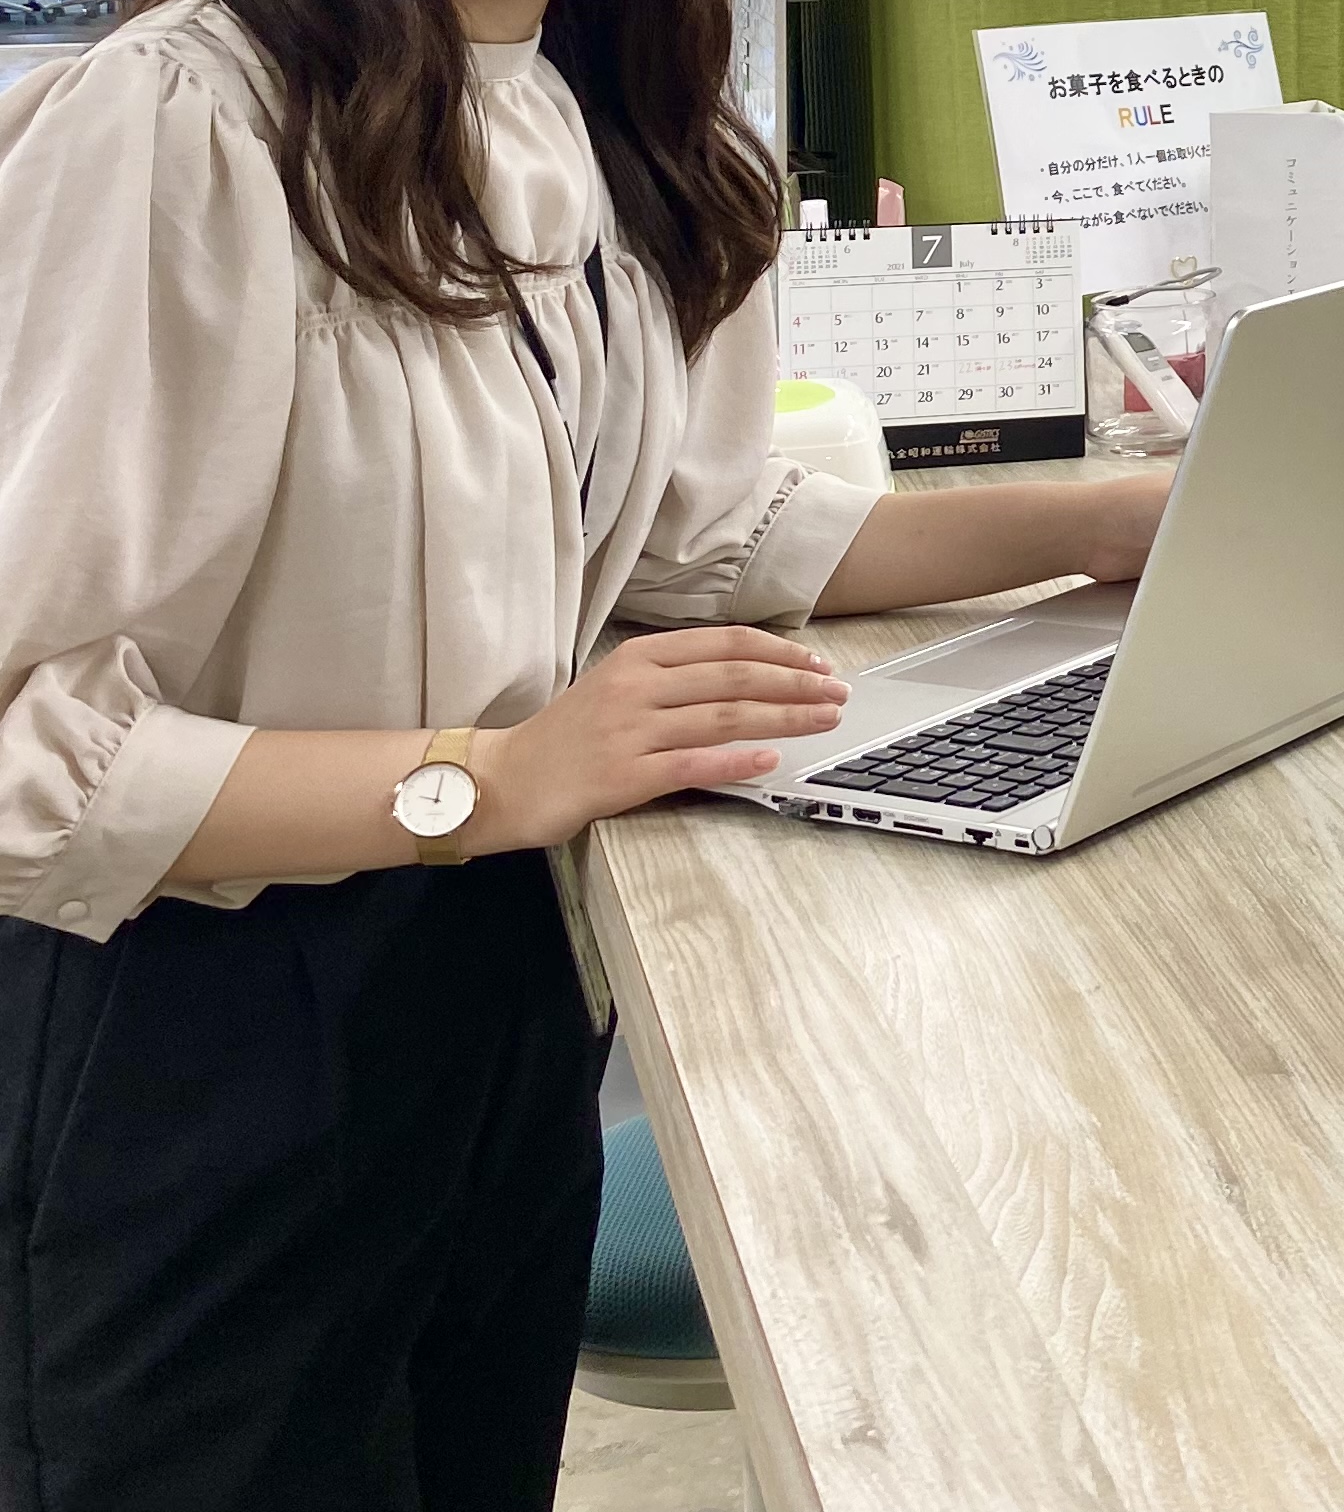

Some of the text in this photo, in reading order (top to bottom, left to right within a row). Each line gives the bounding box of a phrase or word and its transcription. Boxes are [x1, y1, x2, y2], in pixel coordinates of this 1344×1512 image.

[1048, 65, 1224, 99] お菓子を食べるときの
[1118, 104, 1175, 128] RULE
[844, 245, 851, 254] 6
[922, 235, 943, 264] 7
[959, 260, 975, 268] July
[996, 280, 1004, 291] 2
[1035, 278, 1043, 289] 3
[793, 304, 1049, 328] 4 5 6 7 8 9 10
[793, 330, 1050, 355] 11 12 13 14 15 16 17
[793, 371, 807, 380] 18
[876, 366, 892, 378] 20
[917, 364, 930, 376] 21
[1037, 357, 1053, 369] 24
[876, 384, 1051, 406] 27 28 29 30 31
